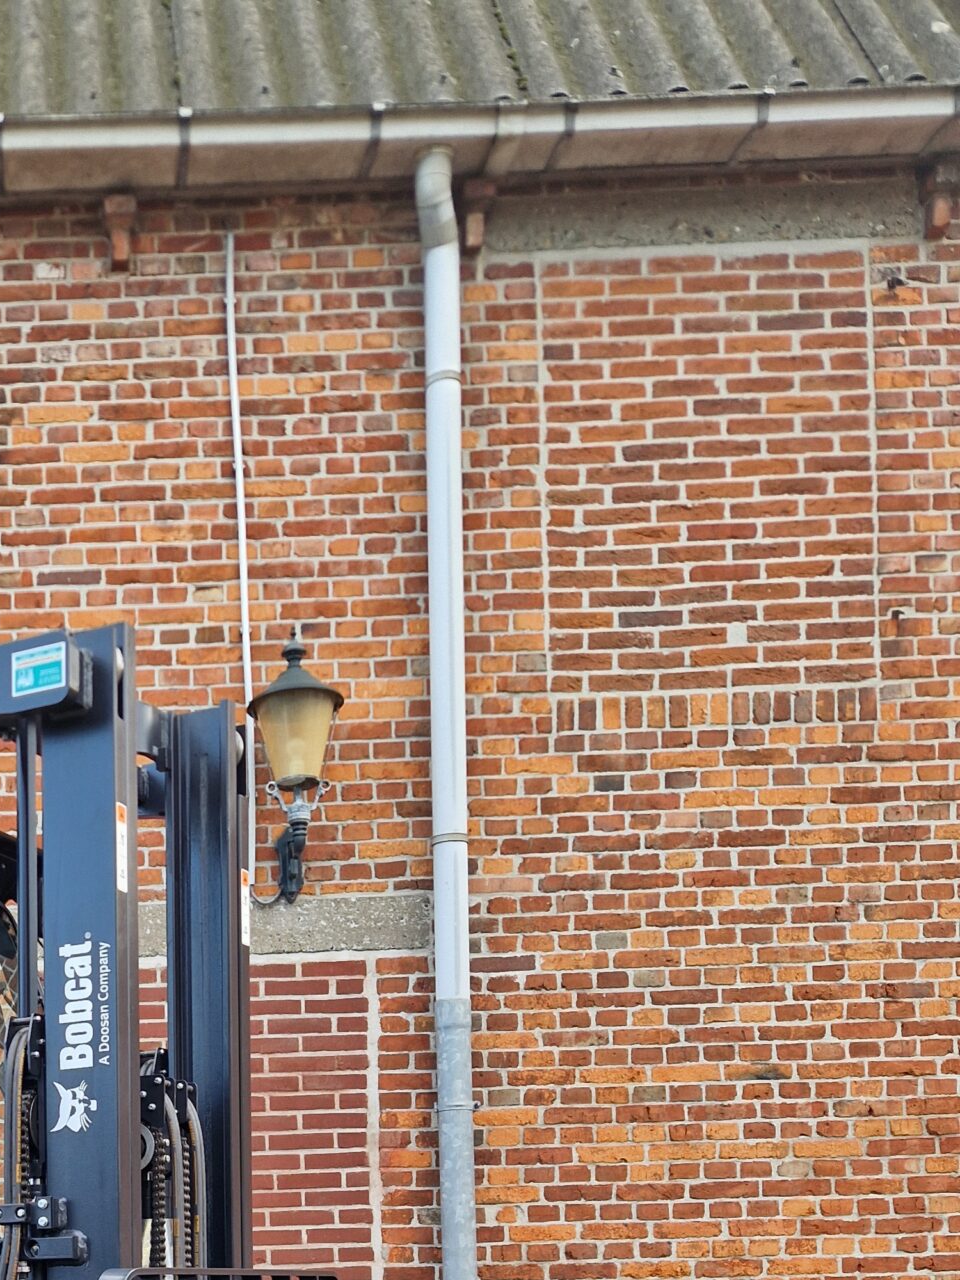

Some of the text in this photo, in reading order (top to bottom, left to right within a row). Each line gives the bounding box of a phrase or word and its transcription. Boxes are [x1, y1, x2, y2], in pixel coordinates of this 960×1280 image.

[97, 942, 111, 1065] A Doosan Company
